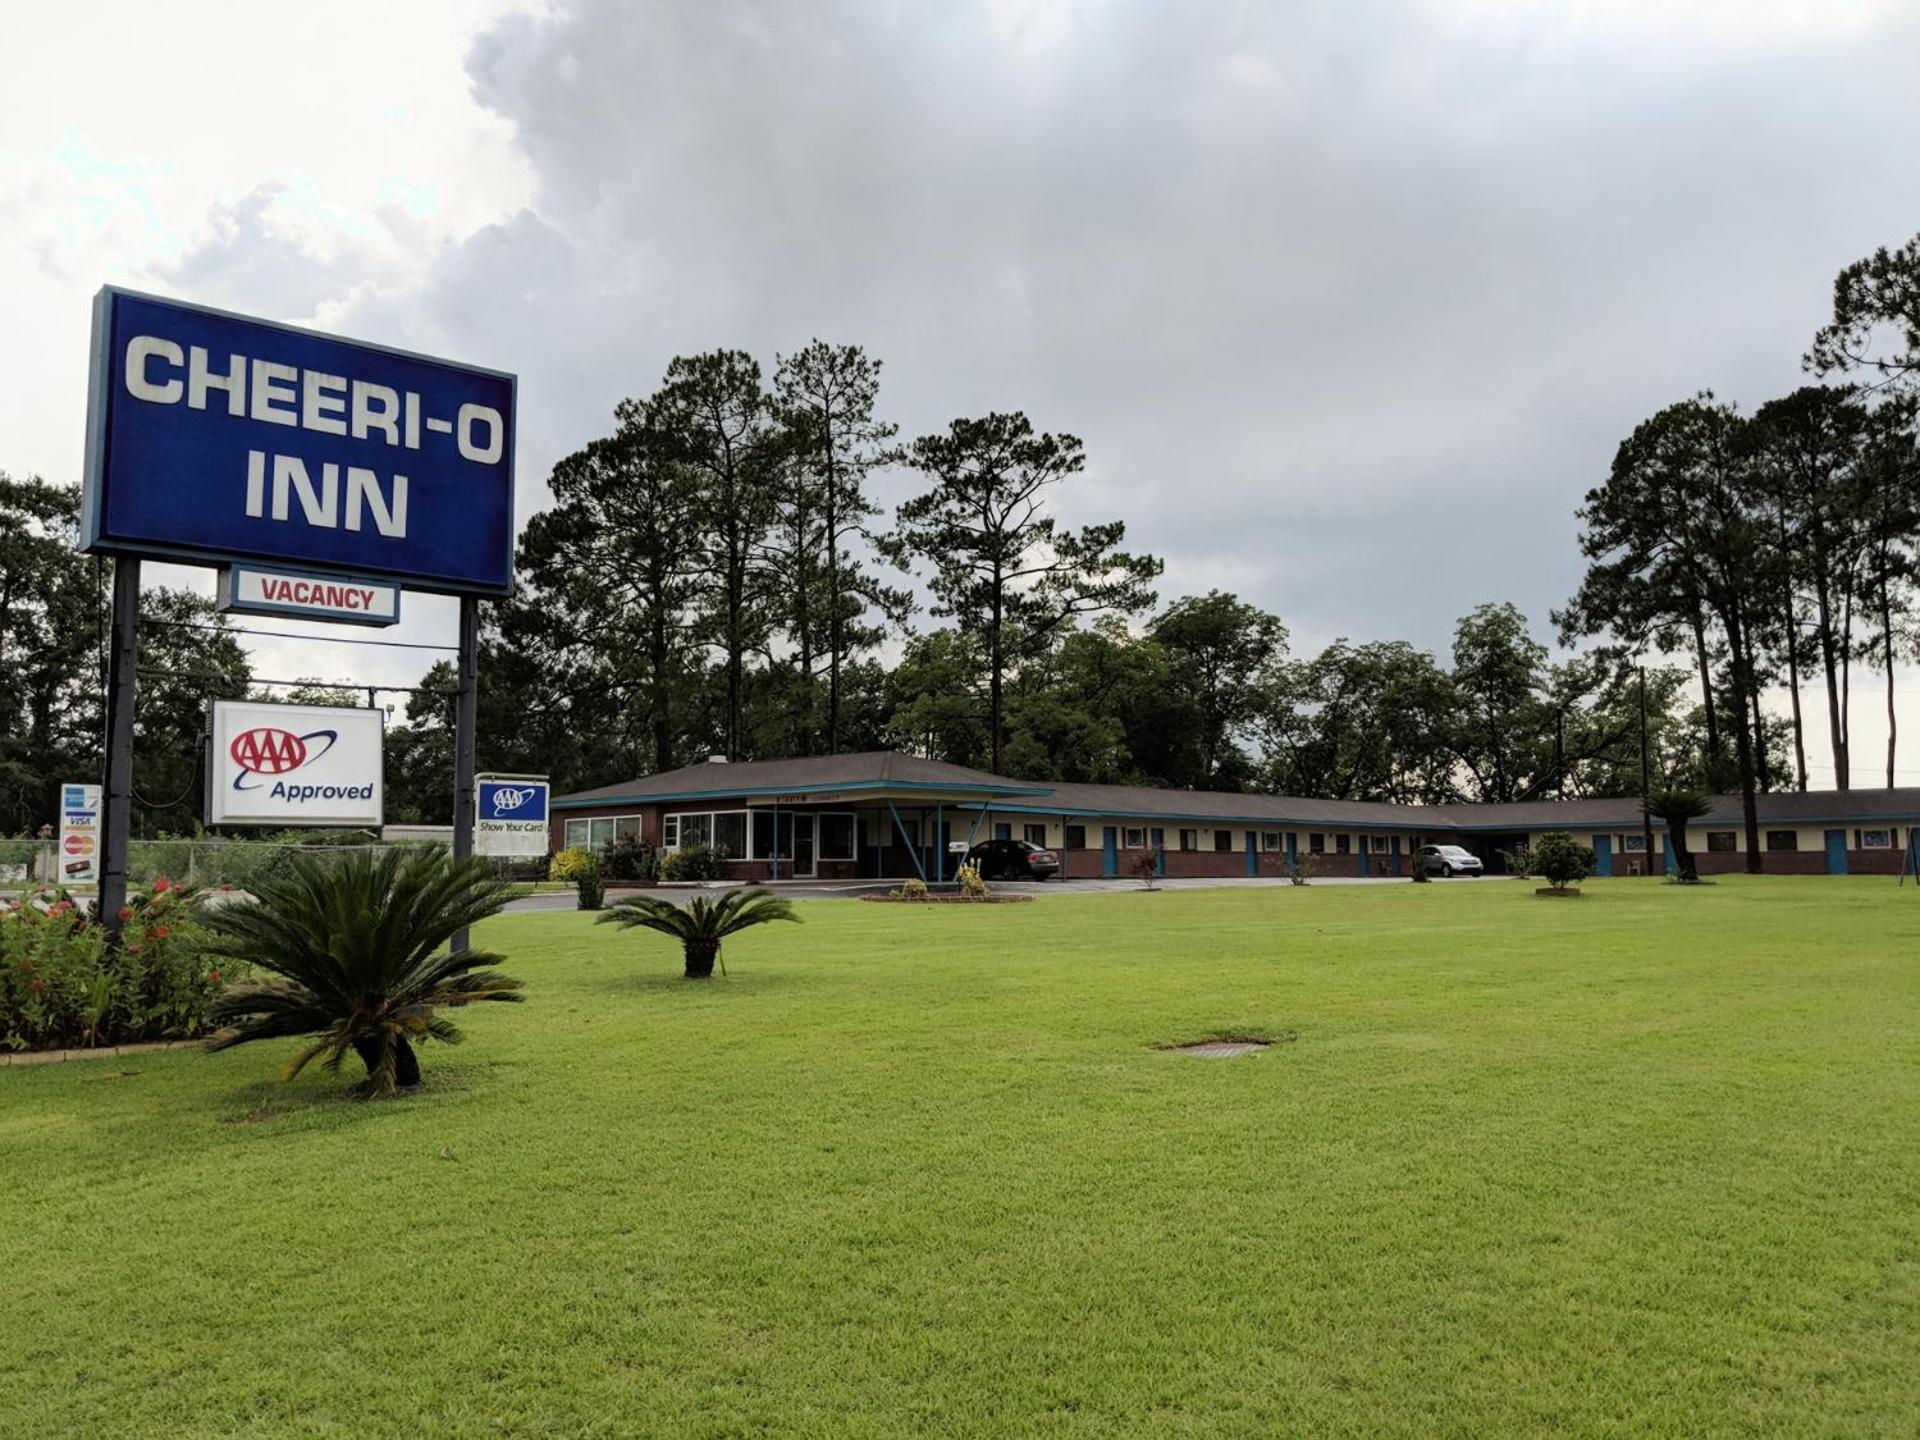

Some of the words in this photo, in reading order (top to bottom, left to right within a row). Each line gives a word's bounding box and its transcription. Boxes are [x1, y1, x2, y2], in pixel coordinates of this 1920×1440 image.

[125, 335, 504, 465] CHEERI-O
[245, 450, 408, 538] INN
[260, 577, 375, 610] VACANCY
[234, 728, 303, 773] AAA
[270, 781, 374, 803] Approved
[495, 788, 521, 809] AAA
[70, 817, 91, 825] VISA
[480, 823, 504, 832] Show
[506, 823, 524, 832] Your
[524, 823, 543, 832] Card
